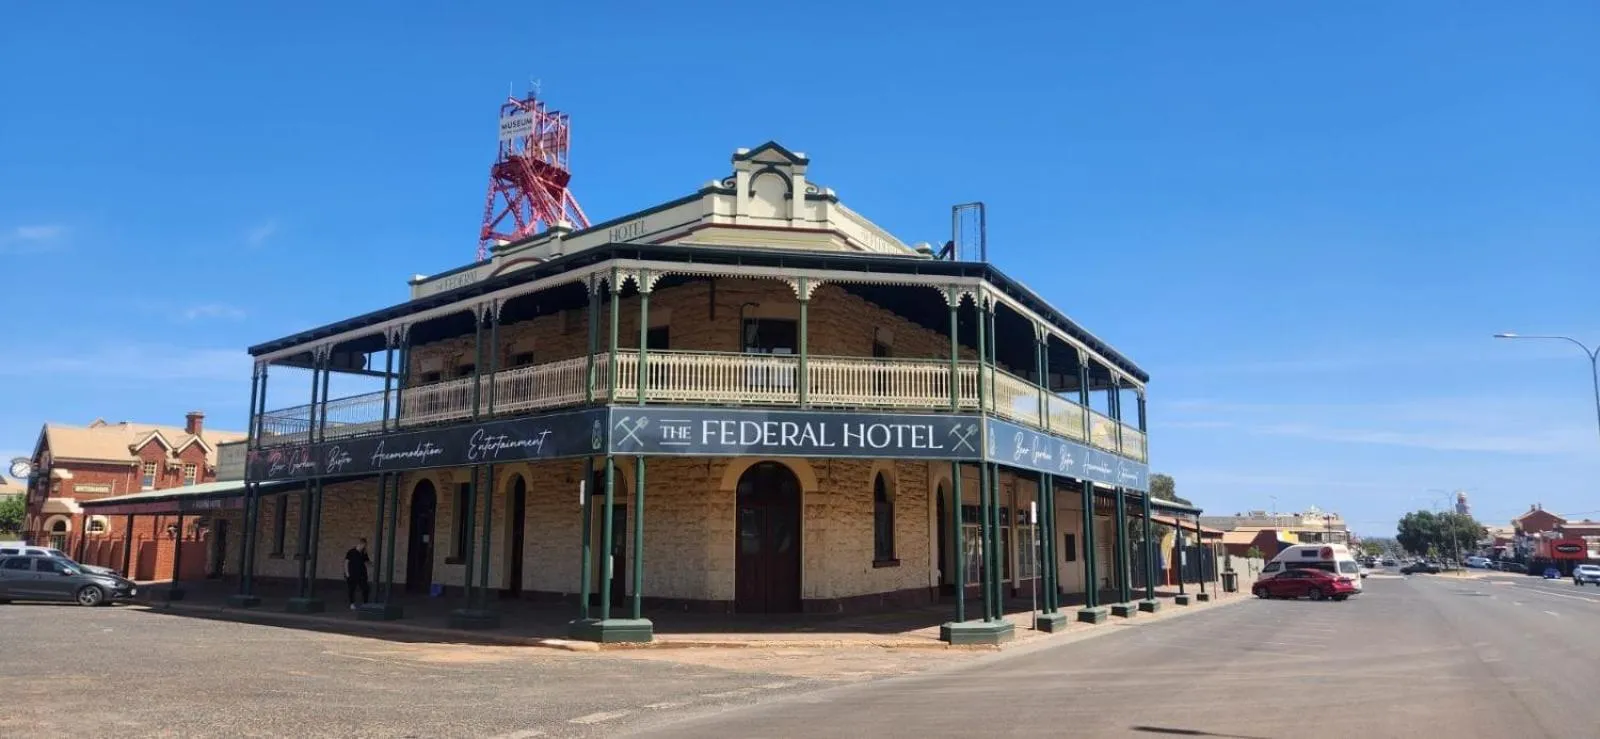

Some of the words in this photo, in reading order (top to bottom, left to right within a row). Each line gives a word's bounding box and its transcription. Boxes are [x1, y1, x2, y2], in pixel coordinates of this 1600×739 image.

[501, 117, 533, 129] MUSEUM
[609, 219, 647, 242] HOTEL
[660, 425, 691, 440] THE
[702, 420, 836, 446] FEDERAL
[843, 422, 944, 449] HOTEL
[1014, 432, 1029, 460] Beer
[327, 445, 353, 473] Bistro
[371, 440, 444, 468] Accommodation
[468, 428, 552, 461] Entertainment
